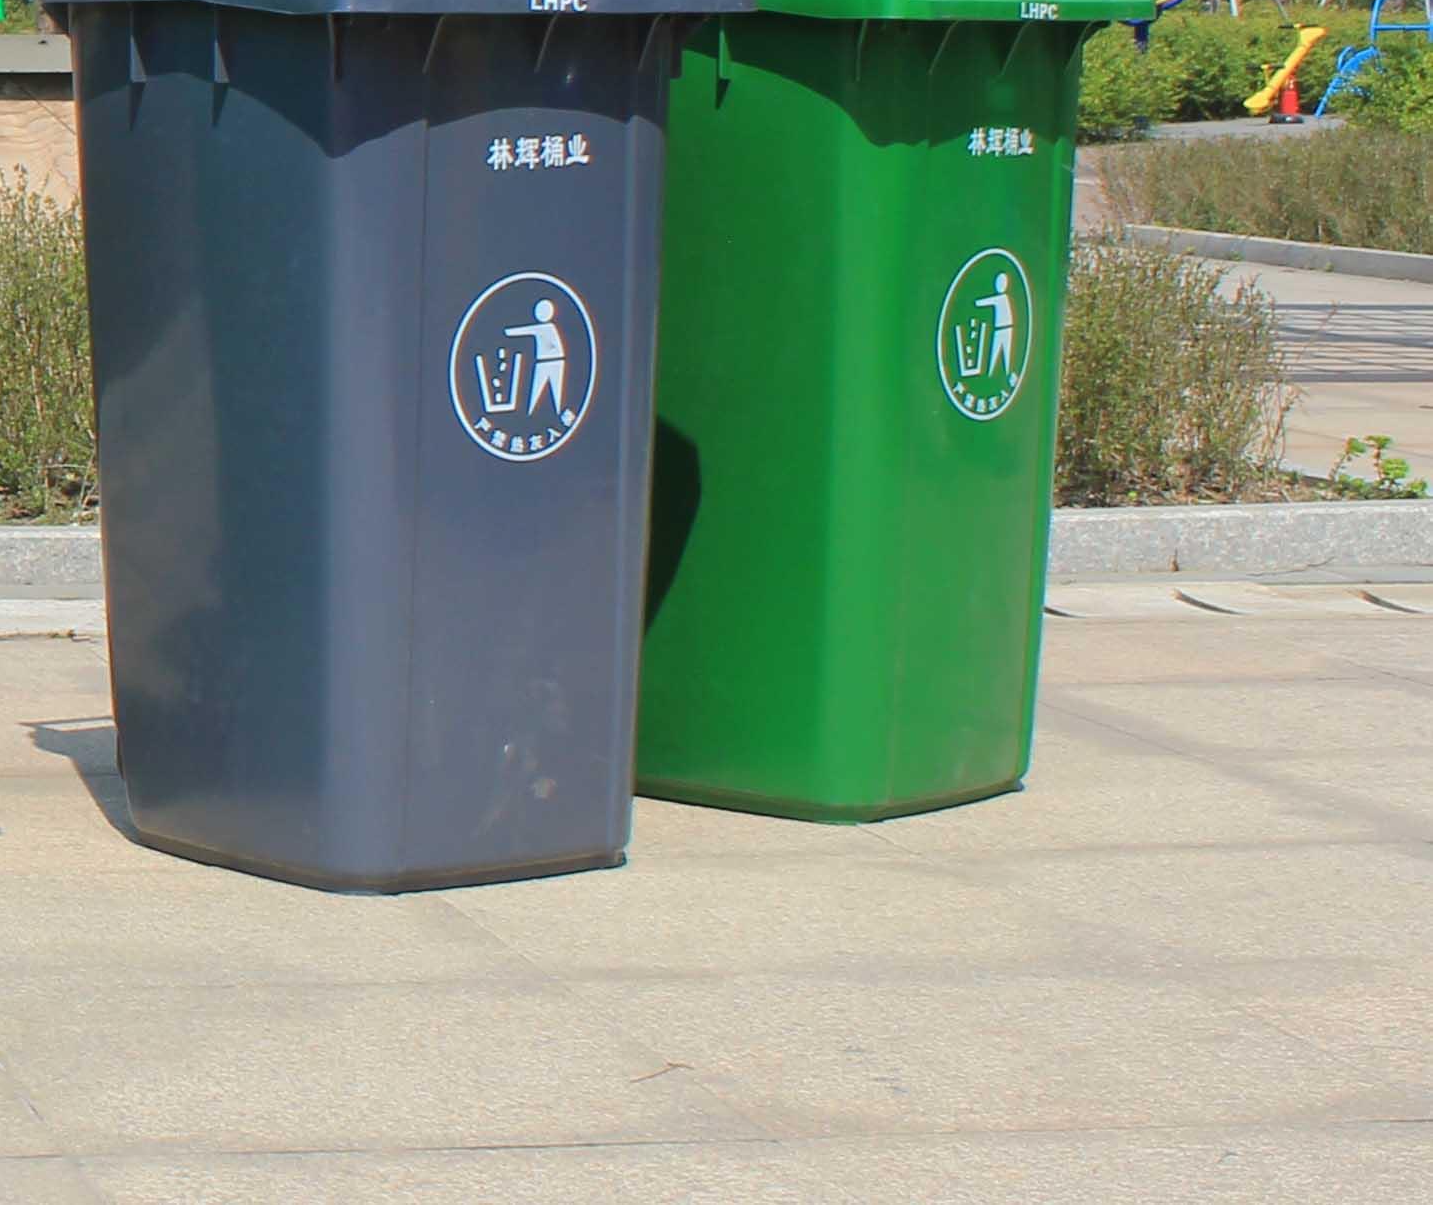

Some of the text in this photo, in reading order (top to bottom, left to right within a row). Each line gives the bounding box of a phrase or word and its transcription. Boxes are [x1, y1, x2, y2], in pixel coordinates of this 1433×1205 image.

[1020, 2, 1059, 20] LHPC
[487, 135, 590, 169] 林辉桶业
